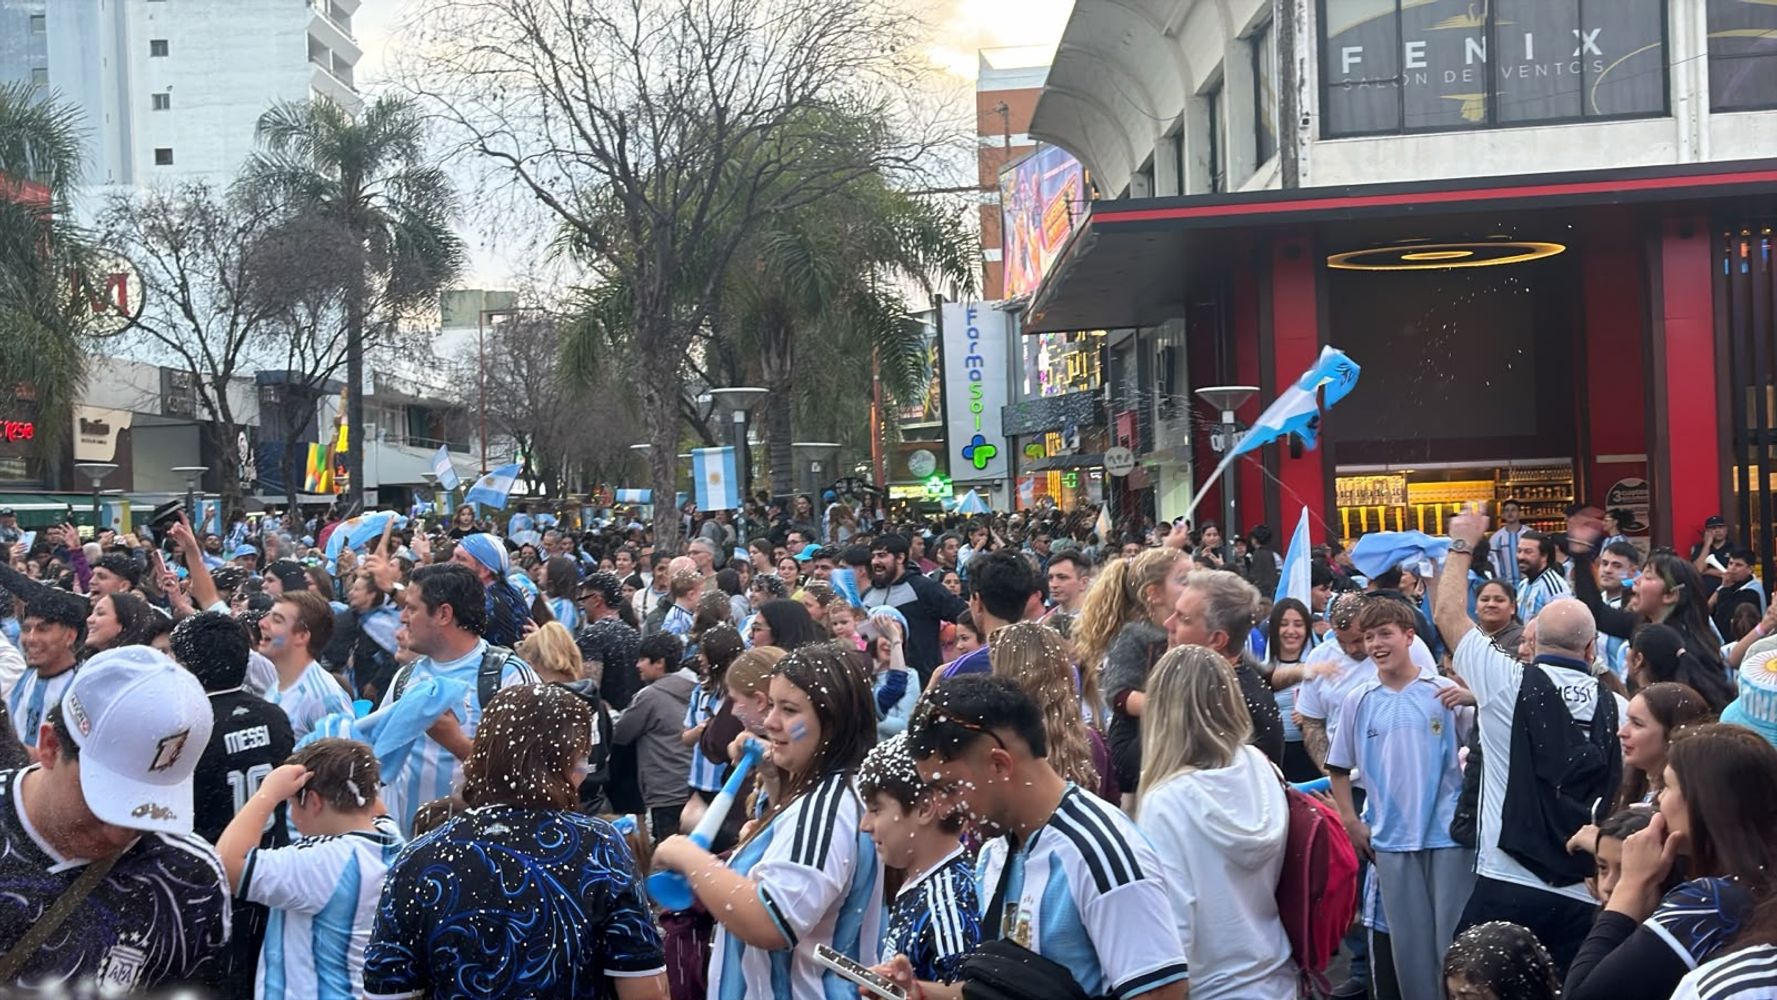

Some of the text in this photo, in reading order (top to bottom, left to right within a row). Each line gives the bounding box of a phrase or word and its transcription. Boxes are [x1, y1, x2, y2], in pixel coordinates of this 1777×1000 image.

[1341, 28, 1603, 74] FENIX
[1444, 69, 1474, 84] DE
[1559, 685, 1592, 703] ESSI
[224, 725, 271, 755] MESSI
